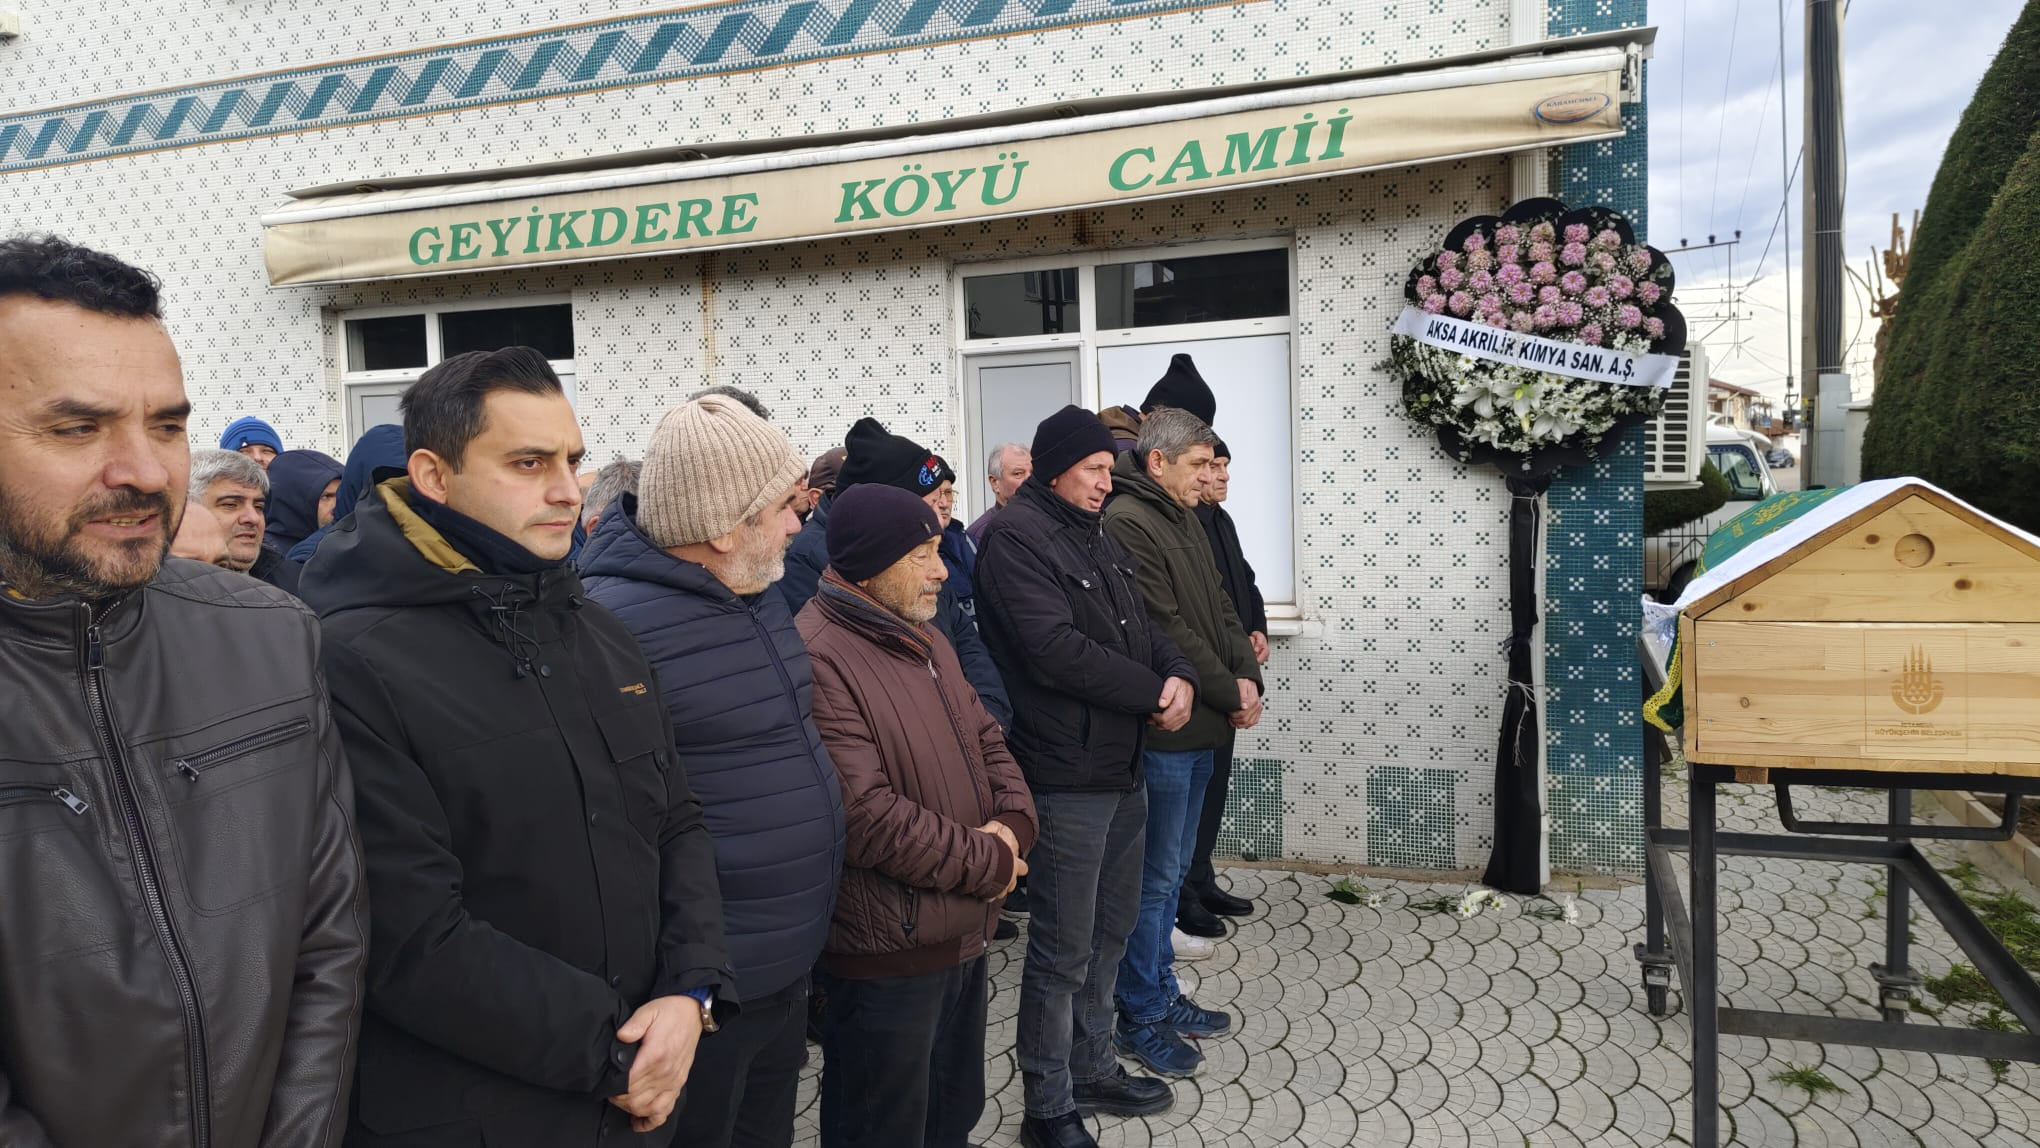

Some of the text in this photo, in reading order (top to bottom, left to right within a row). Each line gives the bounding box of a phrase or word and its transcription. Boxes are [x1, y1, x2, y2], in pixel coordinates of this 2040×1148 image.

[409, 107, 1354, 266] GEYİKDERE KÖYÜ CAMİİ
[1426, 319, 1636, 382] AKSA AKRİLİK KİMYA SAN. A.Ş.
